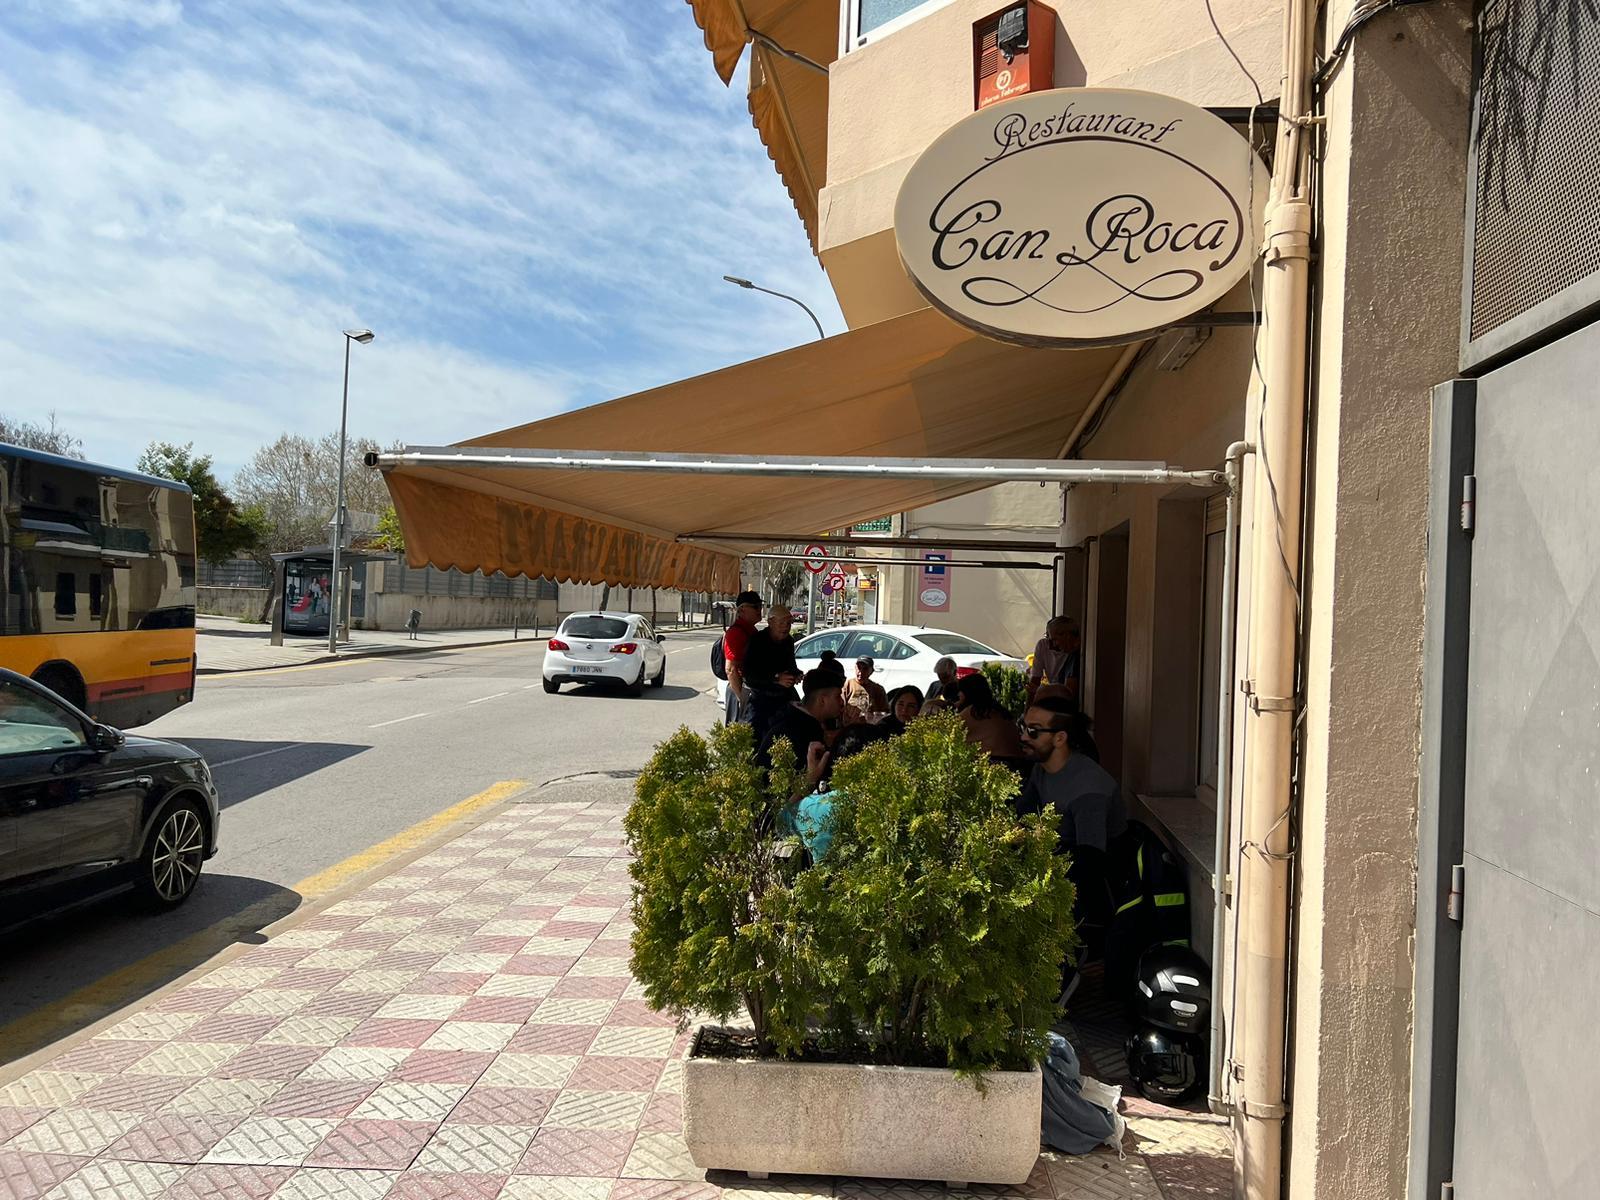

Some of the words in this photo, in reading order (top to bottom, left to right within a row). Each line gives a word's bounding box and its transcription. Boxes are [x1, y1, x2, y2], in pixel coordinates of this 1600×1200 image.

[984, 102, 1183, 161] Restaurant
[930, 200, 1050, 271] Can
[1056, 194, 1230, 266] Roca
